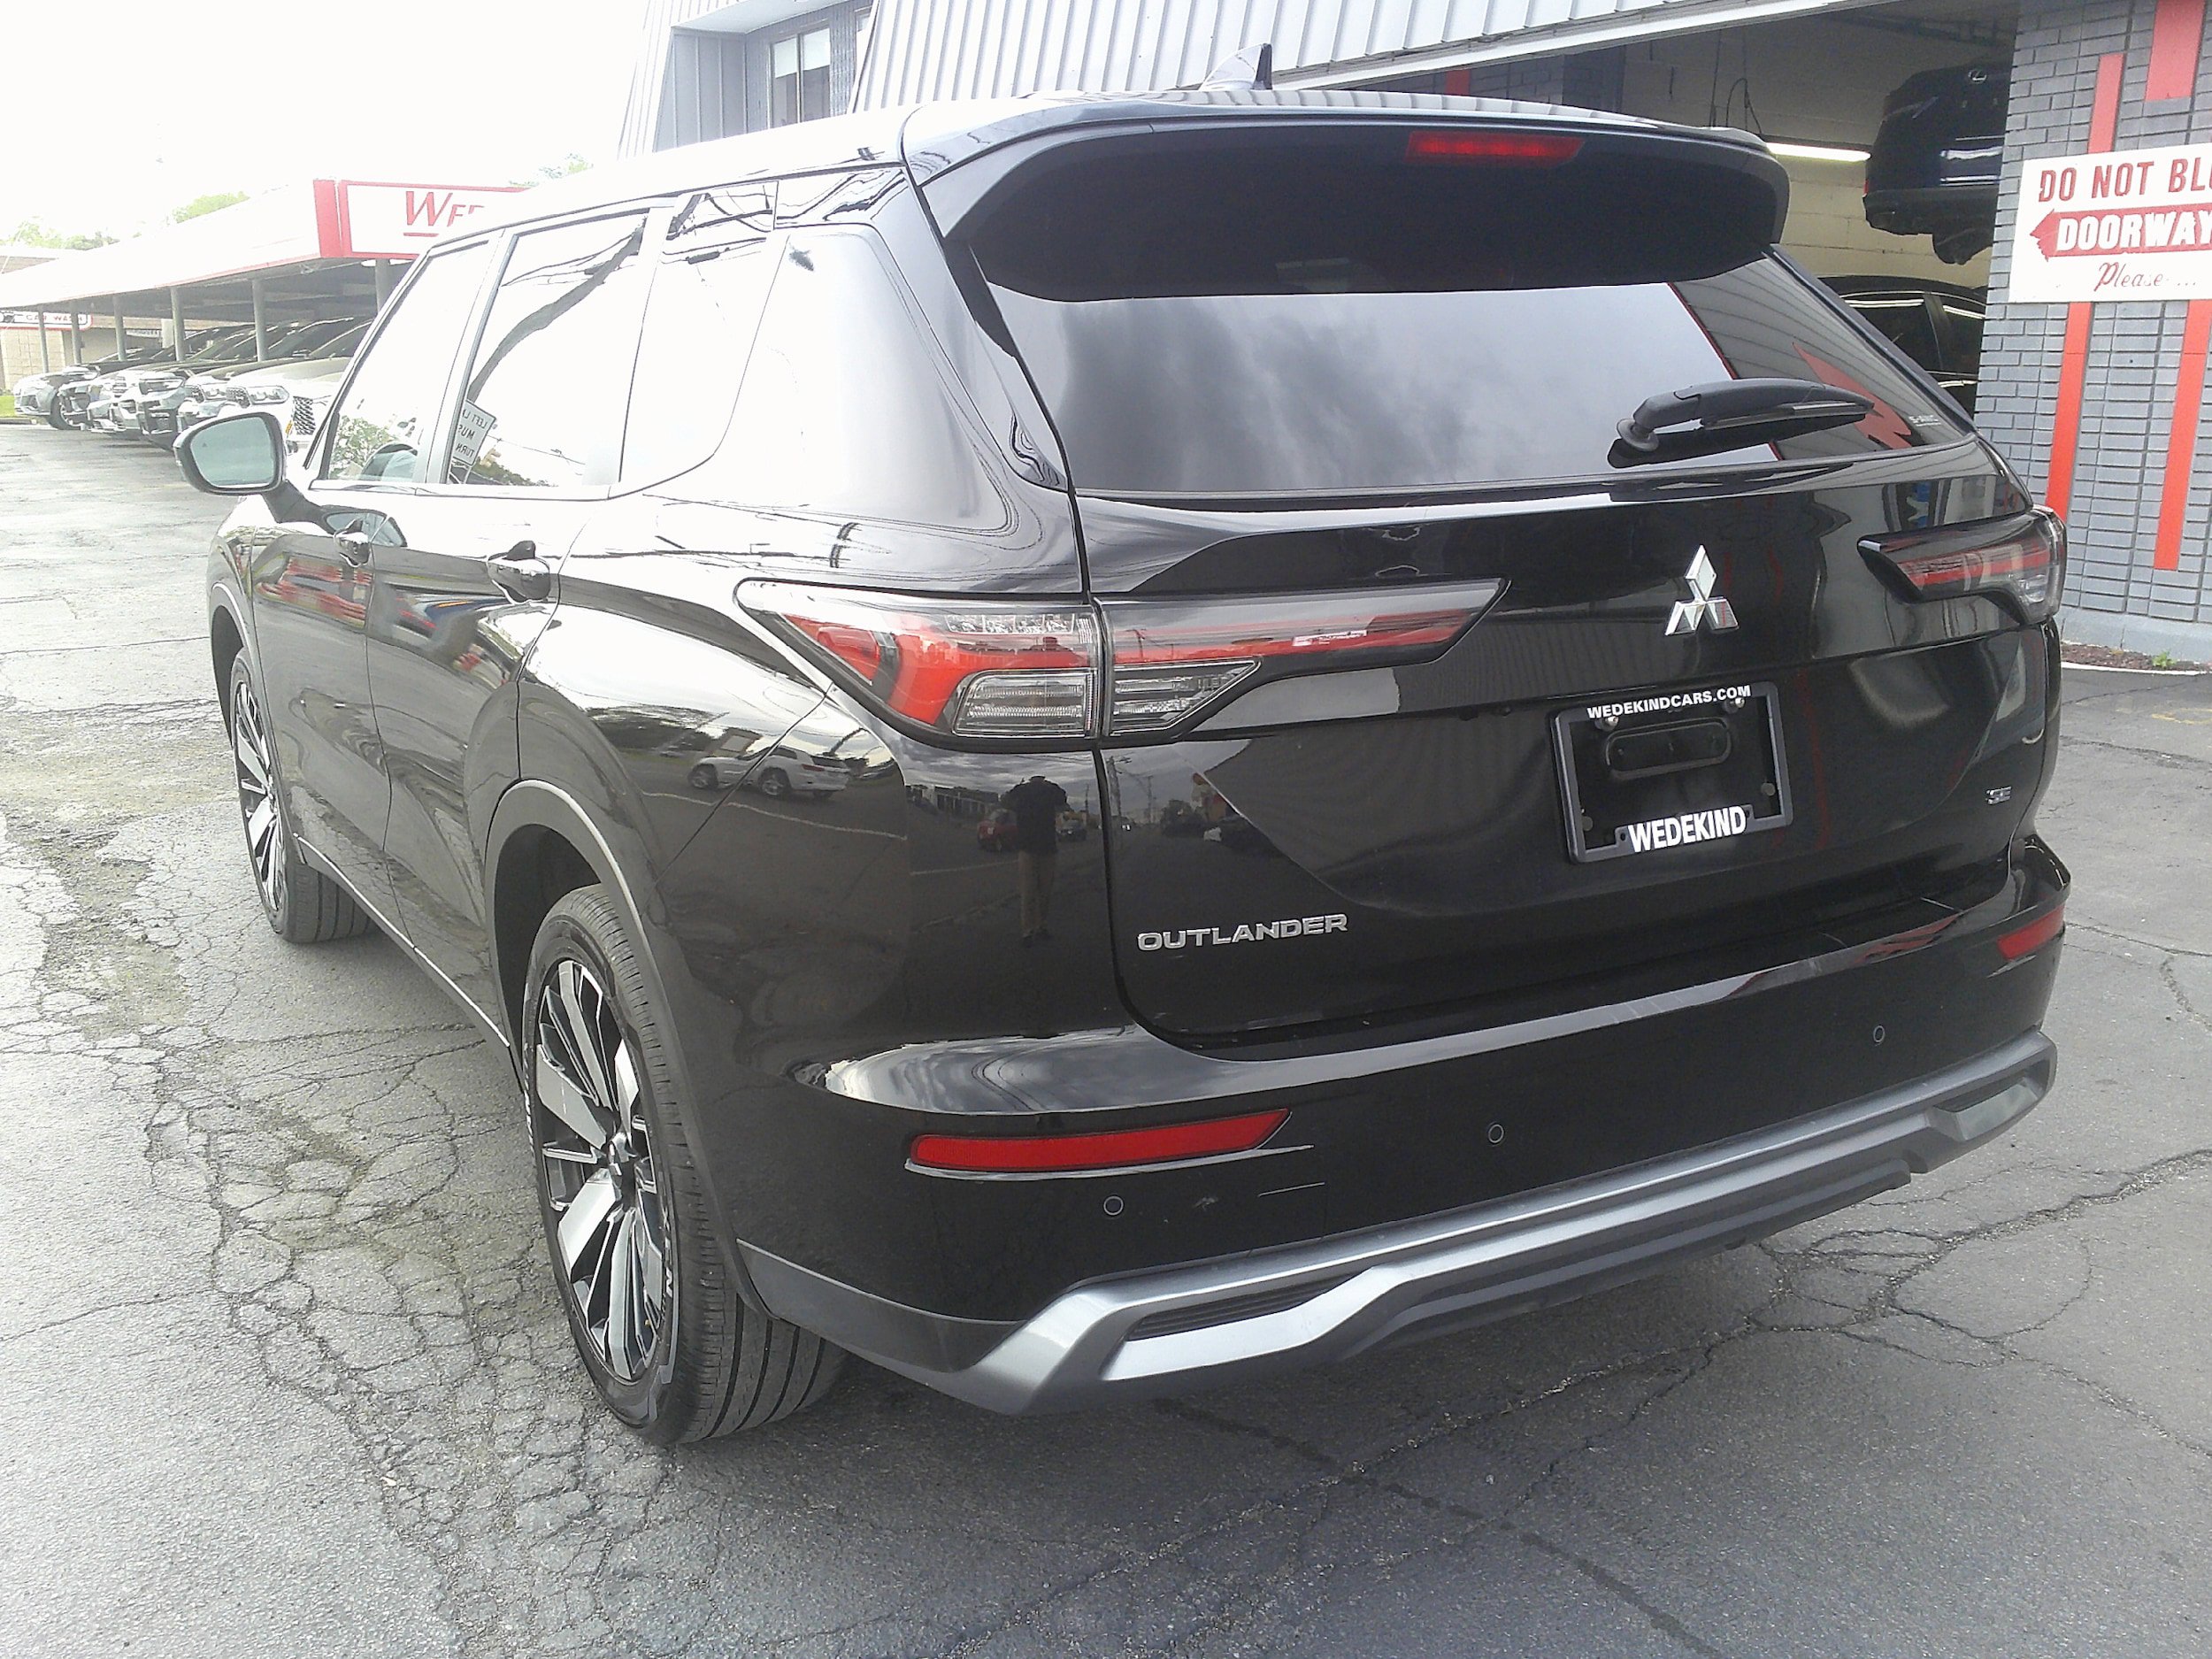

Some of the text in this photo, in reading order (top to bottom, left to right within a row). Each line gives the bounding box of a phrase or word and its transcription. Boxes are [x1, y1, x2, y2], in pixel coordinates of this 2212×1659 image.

[2038, 157, 2212, 203] DO NOT BL
[1586, 685, 1752, 719] WEDEKINDCARS.COM
[1627, 805, 1747, 853] WEDEKIND
[1137, 913, 1348, 951] OUTLANDER
